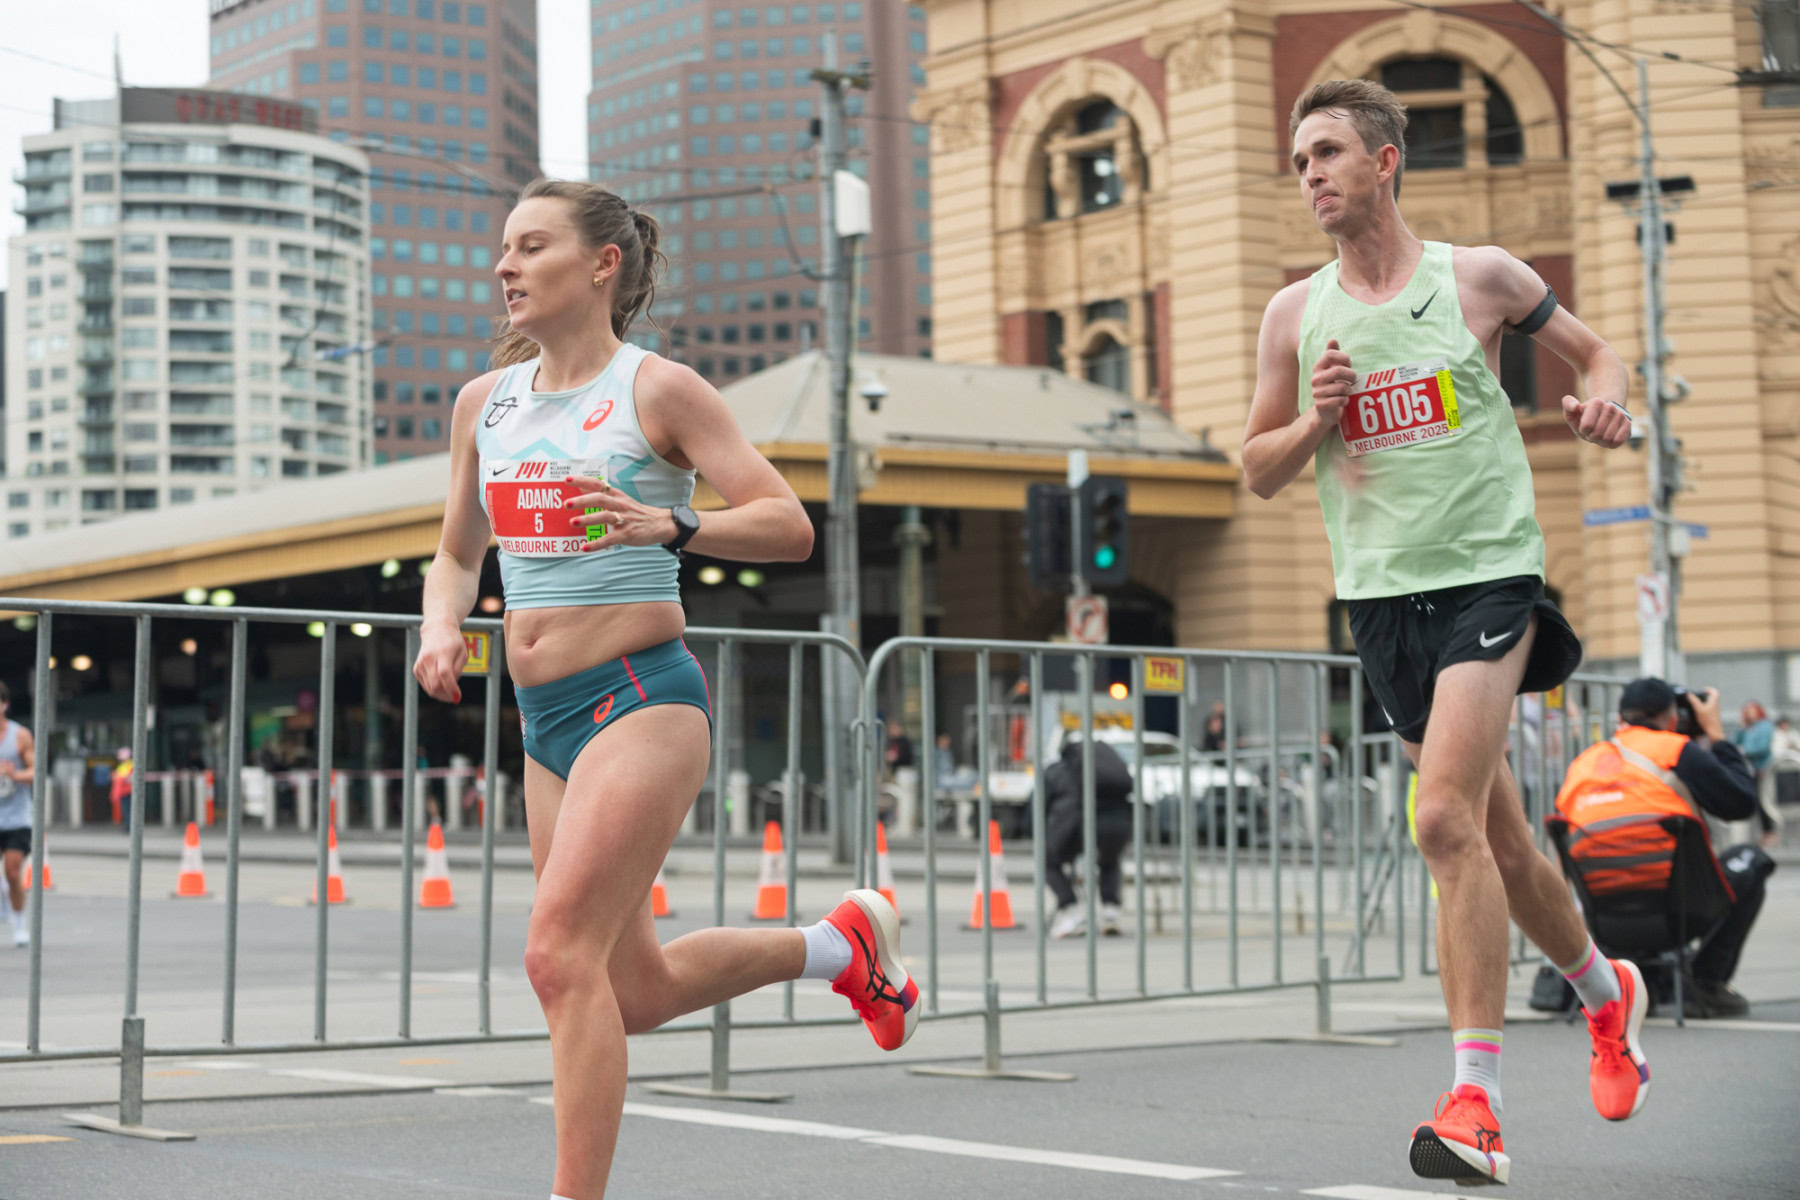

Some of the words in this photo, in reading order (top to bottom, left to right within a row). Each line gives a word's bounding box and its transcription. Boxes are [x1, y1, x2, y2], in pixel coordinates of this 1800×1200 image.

[1357, 383, 1433, 435] 6105
[1354, 430, 1418, 453] MELBOURNE
[1421, 423, 1449, 439] 2025
[517, 488, 563, 510] ADAMS
[534, 512, 544, 534] 5
[501, 540, 558, 553] MELBOURNE
